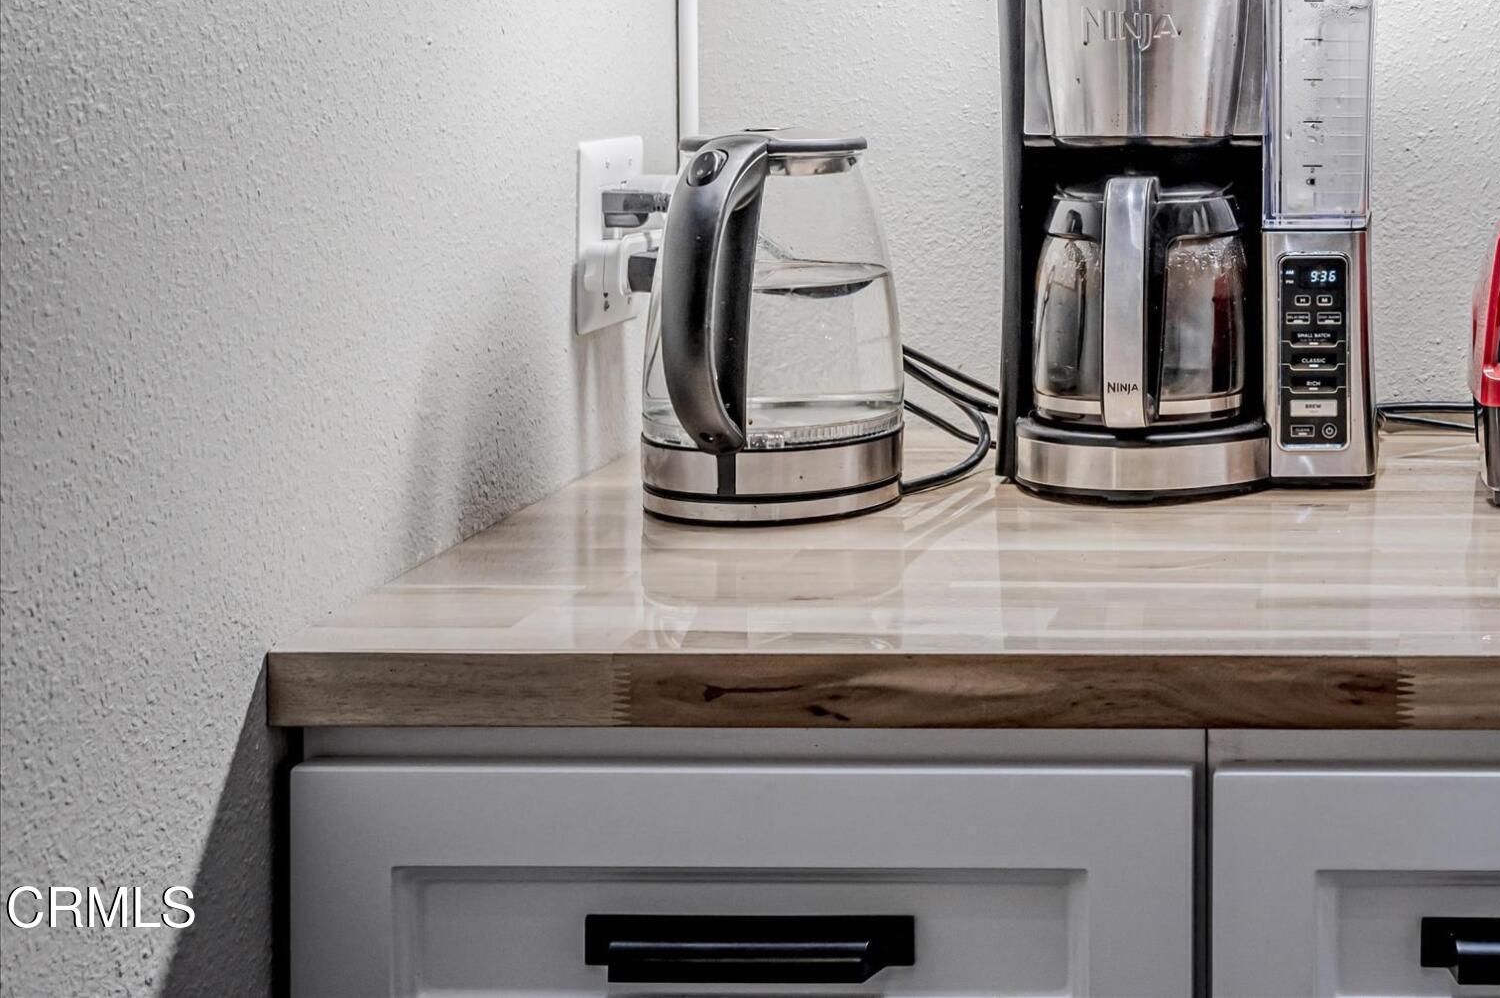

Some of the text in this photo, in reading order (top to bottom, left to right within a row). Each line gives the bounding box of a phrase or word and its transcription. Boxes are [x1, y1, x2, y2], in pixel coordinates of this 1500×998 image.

[1080, 5, 1179, 52] NINJA
[1310, 270, 1337, 283] 9:36
[1107, 381, 1139, 394] NINJA
